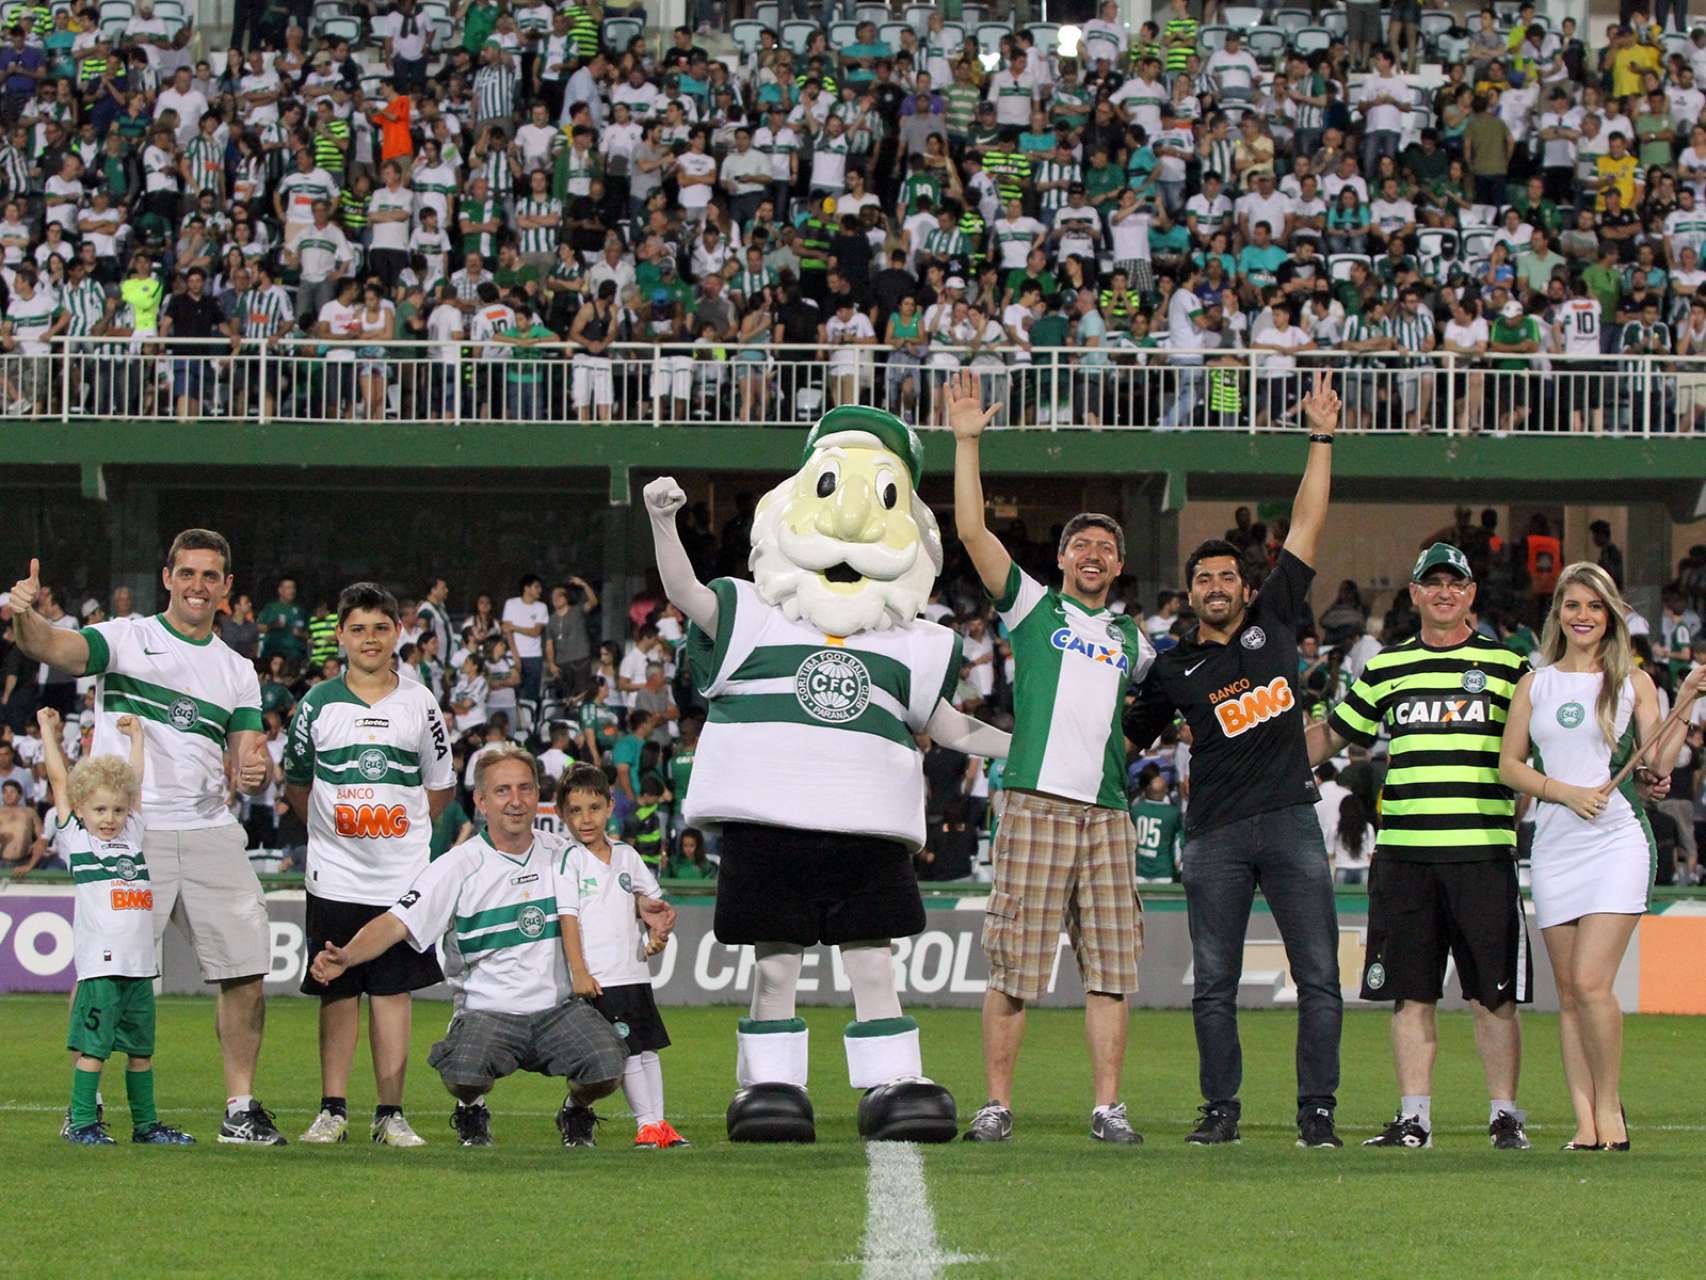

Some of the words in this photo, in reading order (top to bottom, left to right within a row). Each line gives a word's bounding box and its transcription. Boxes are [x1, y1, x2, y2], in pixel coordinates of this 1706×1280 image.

[1576, 312, 1595, 334] 10
[1051, 627, 1130, 678] CAIXA
[798, 658, 820, 701] CORITIBA
[820, 653, 847, 662] FOOT
[812, 674, 856, 697] CFC
[1208, 678, 1250, 705] BANCO
[1215, 676, 1296, 738] BMG
[1396, 700, 1485, 724] CAIXA
[430, 720, 448, 761] IRA
[336, 788, 374, 799] BANCO
[335, 804, 411, 839] BMG
[111, 889, 153, 911] BMG
[694, 930, 1072, 993] CEROLT
[84, 1006, 102, 1031] 5
